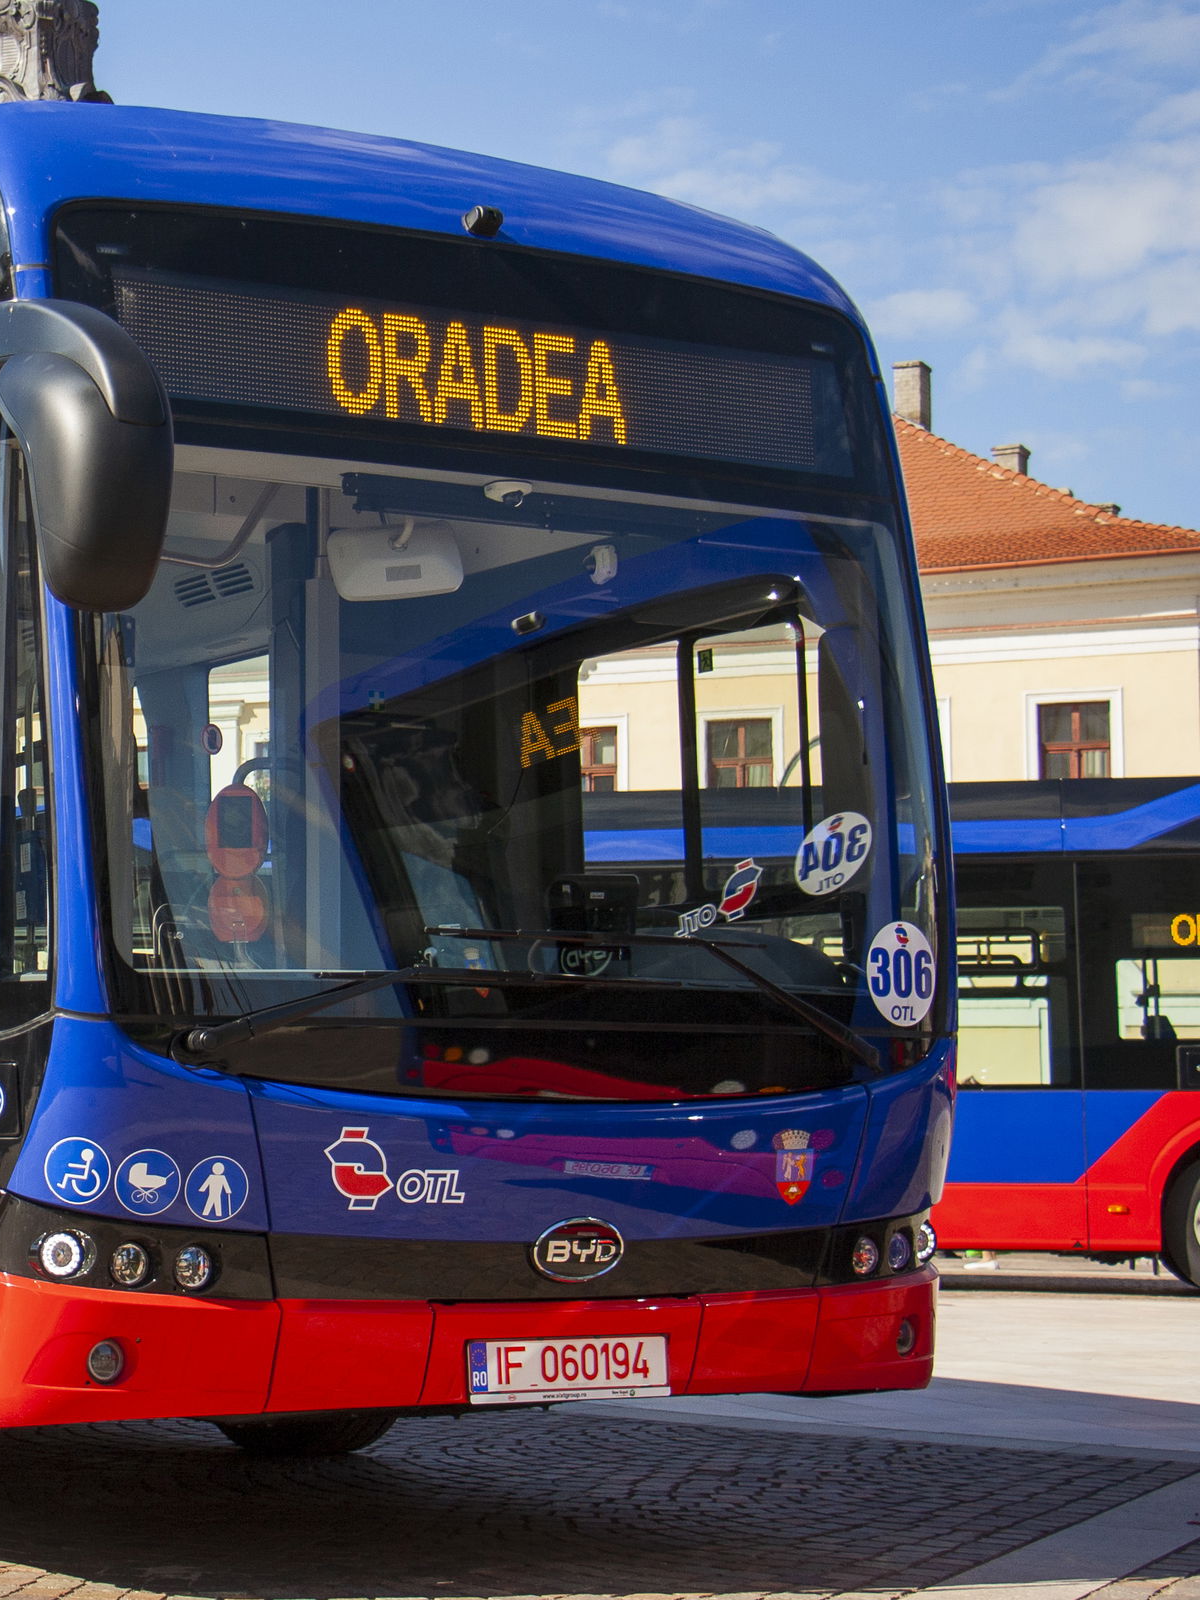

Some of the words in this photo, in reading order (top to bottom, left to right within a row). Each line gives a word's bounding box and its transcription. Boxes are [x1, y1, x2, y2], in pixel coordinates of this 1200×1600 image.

[327, 307, 627, 445] ORADEA
[870, 946, 933, 1000] 306
[890, 1004, 917, 1021] OTL
[396, 1169, 465, 1204] OTL
[545, 1239, 617, 1263] BYD
[472, 1371, 487, 1387] RO
[496, 1346, 526, 1385] IF
[540, 1341, 650, 1383] 060194
